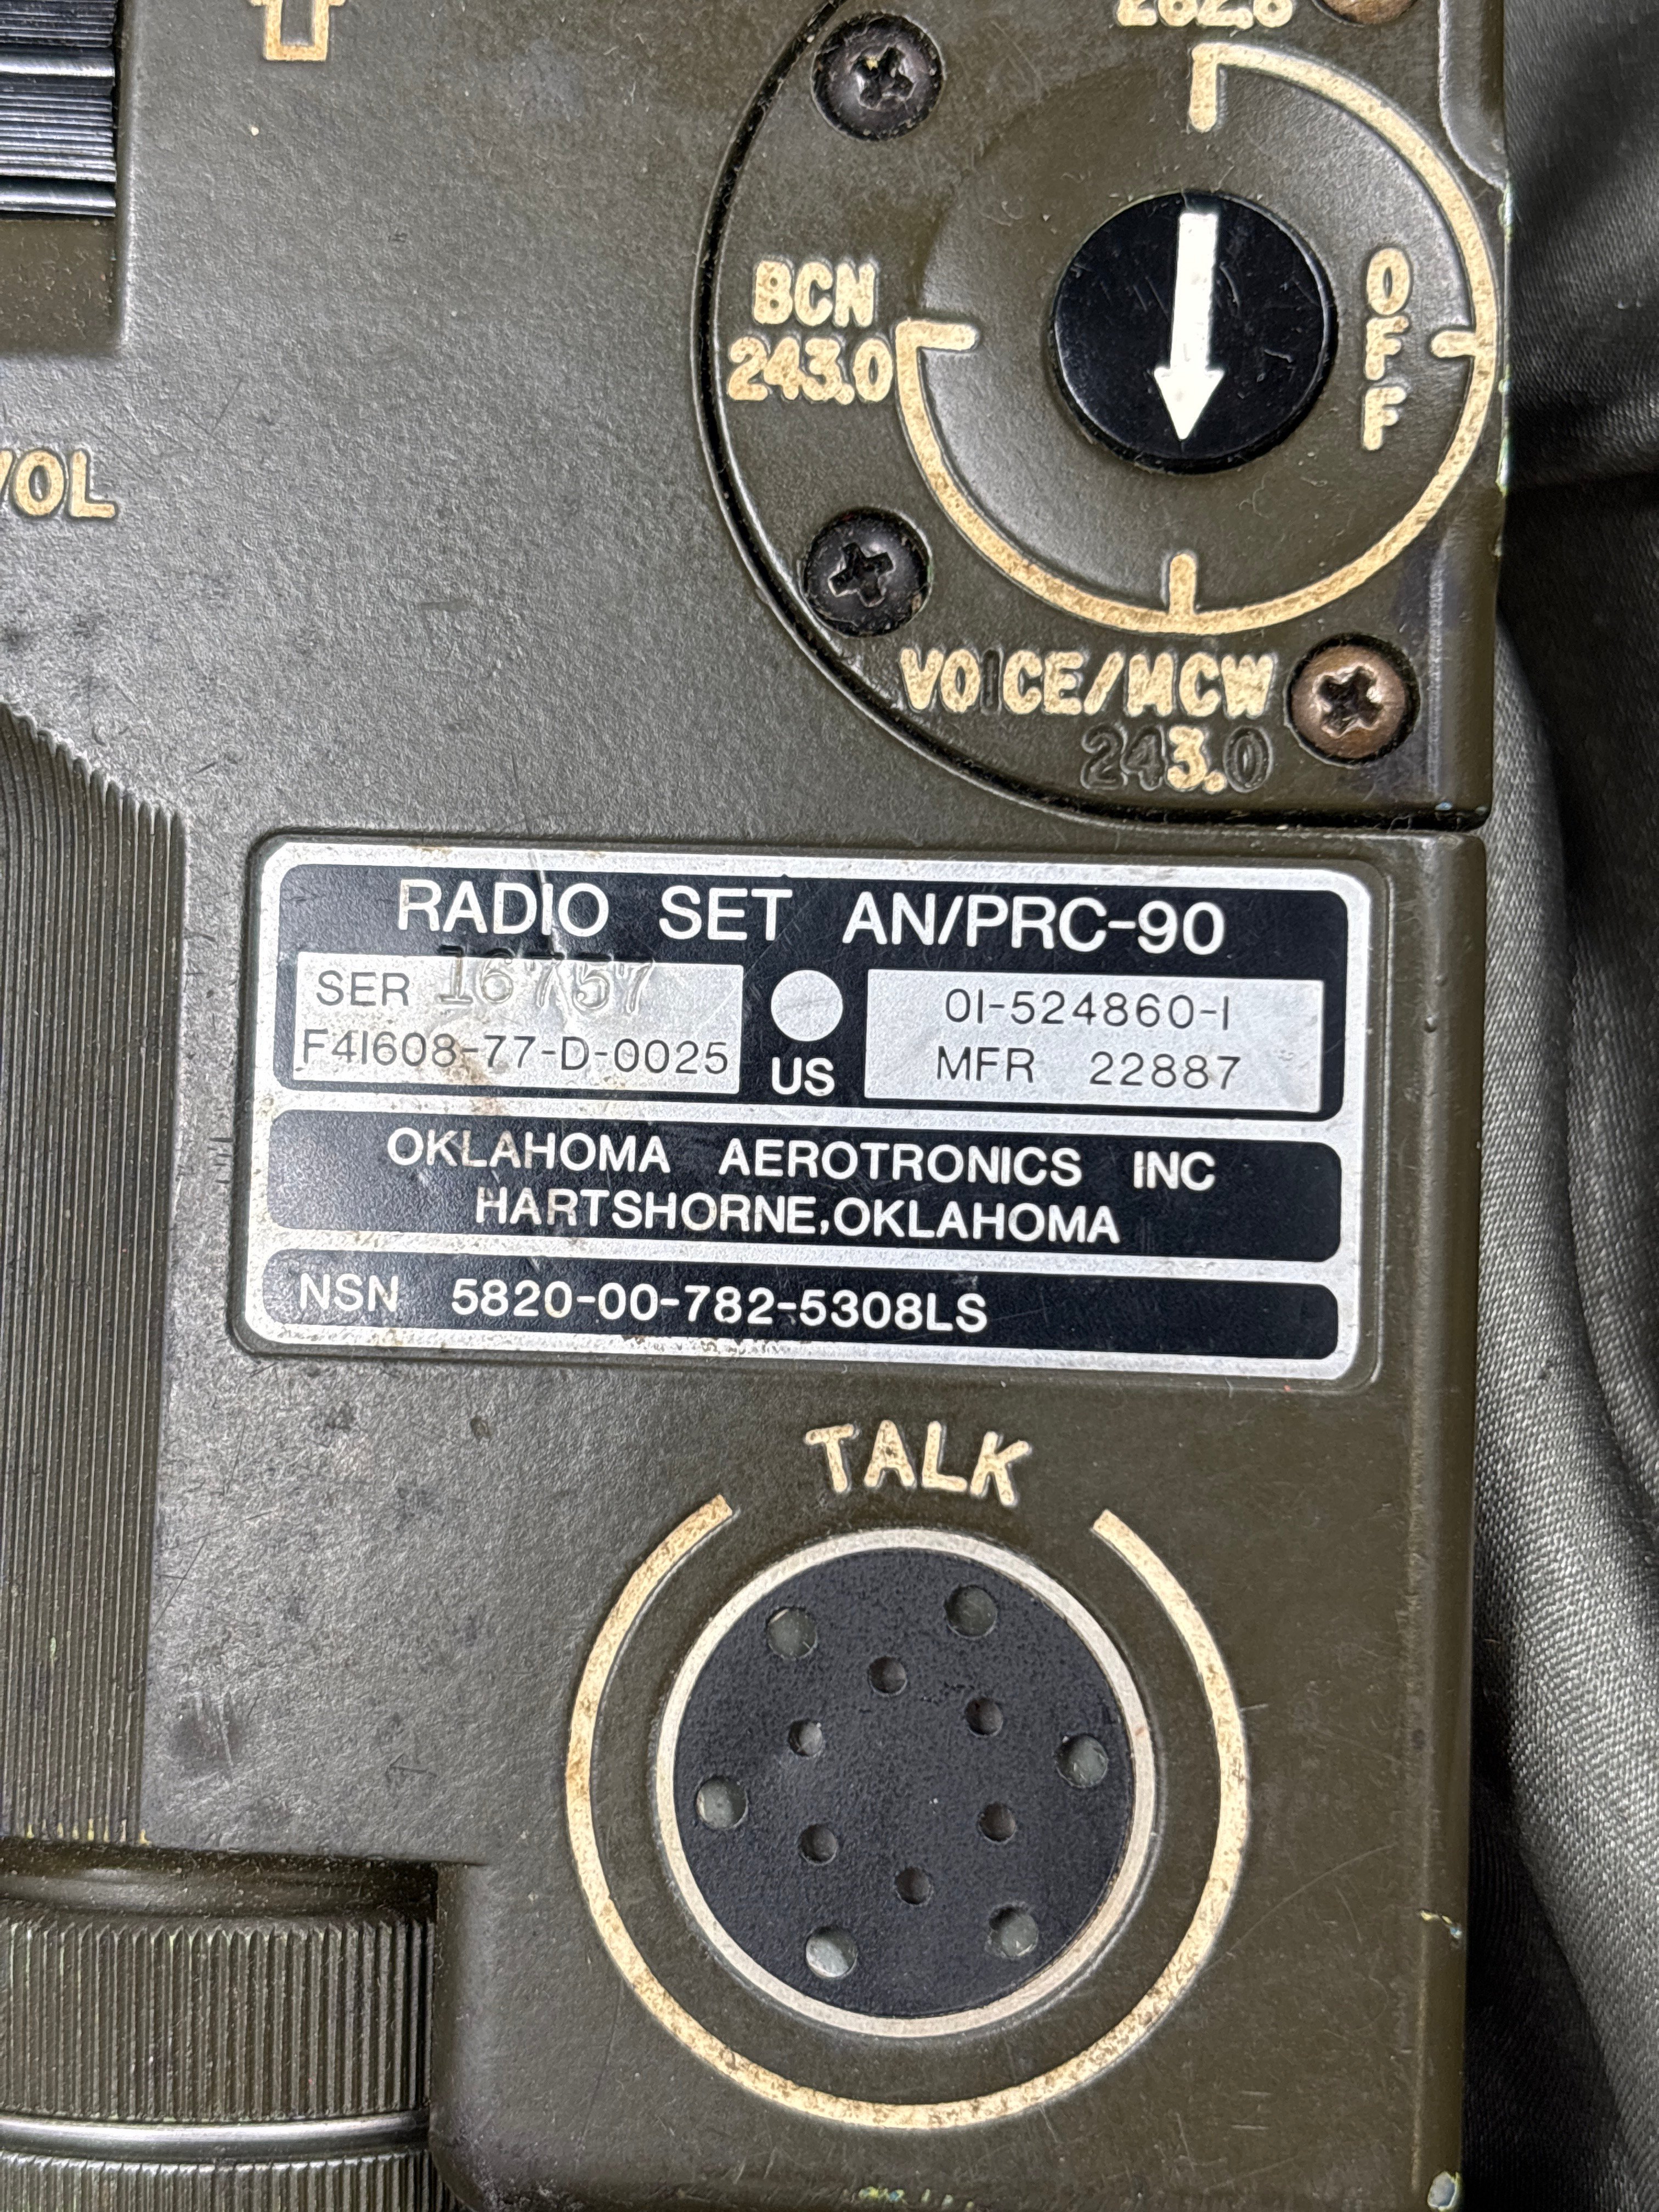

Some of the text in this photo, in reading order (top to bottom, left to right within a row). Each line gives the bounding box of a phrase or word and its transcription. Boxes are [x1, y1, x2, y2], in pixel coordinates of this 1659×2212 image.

[753, 260, 876, 327] BCN
[727, 336, 894, 405] 243.0
[1363, 247, 1411, 451] OFF
[900, 648, 1275, 718] VOICE/MCW
[1081, 725, 1272, 793] 243.0
[397, 879, 1227, 956] RADIO SET AN/PRC-90
[315, 944, 655, 1015] SER 16757
[772, 1057, 834, 1097] US
[936, 1047, 1241, 1091] MFR 22887
[387, 1127, 1216, 1192] OKLAHOMA AEROTRONICS INC
[299, 1273, 988, 1334] NSN 5820-00-782-5308LS
[804, 1420, 1031, 1506] TALK
